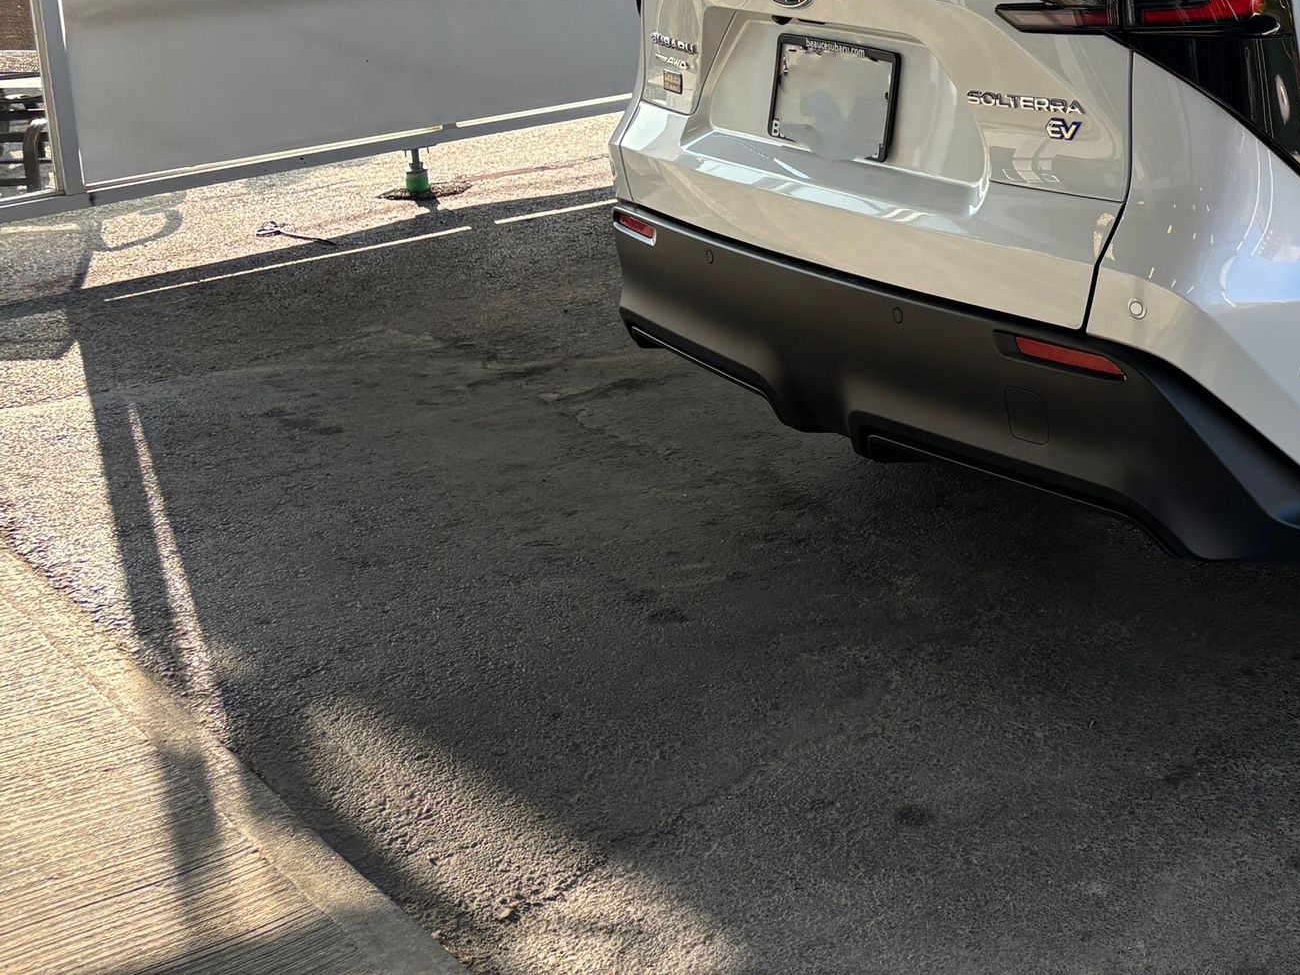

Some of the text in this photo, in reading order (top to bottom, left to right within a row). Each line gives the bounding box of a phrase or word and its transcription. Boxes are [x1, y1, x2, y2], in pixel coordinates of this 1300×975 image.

[805, 37, 866, 57] beaucesubaru.com
[666, 56, 689, 70] AWD
[967, 90, 1085, 115] SOLTERRA
[1044, 117, 1083, 140] EV
